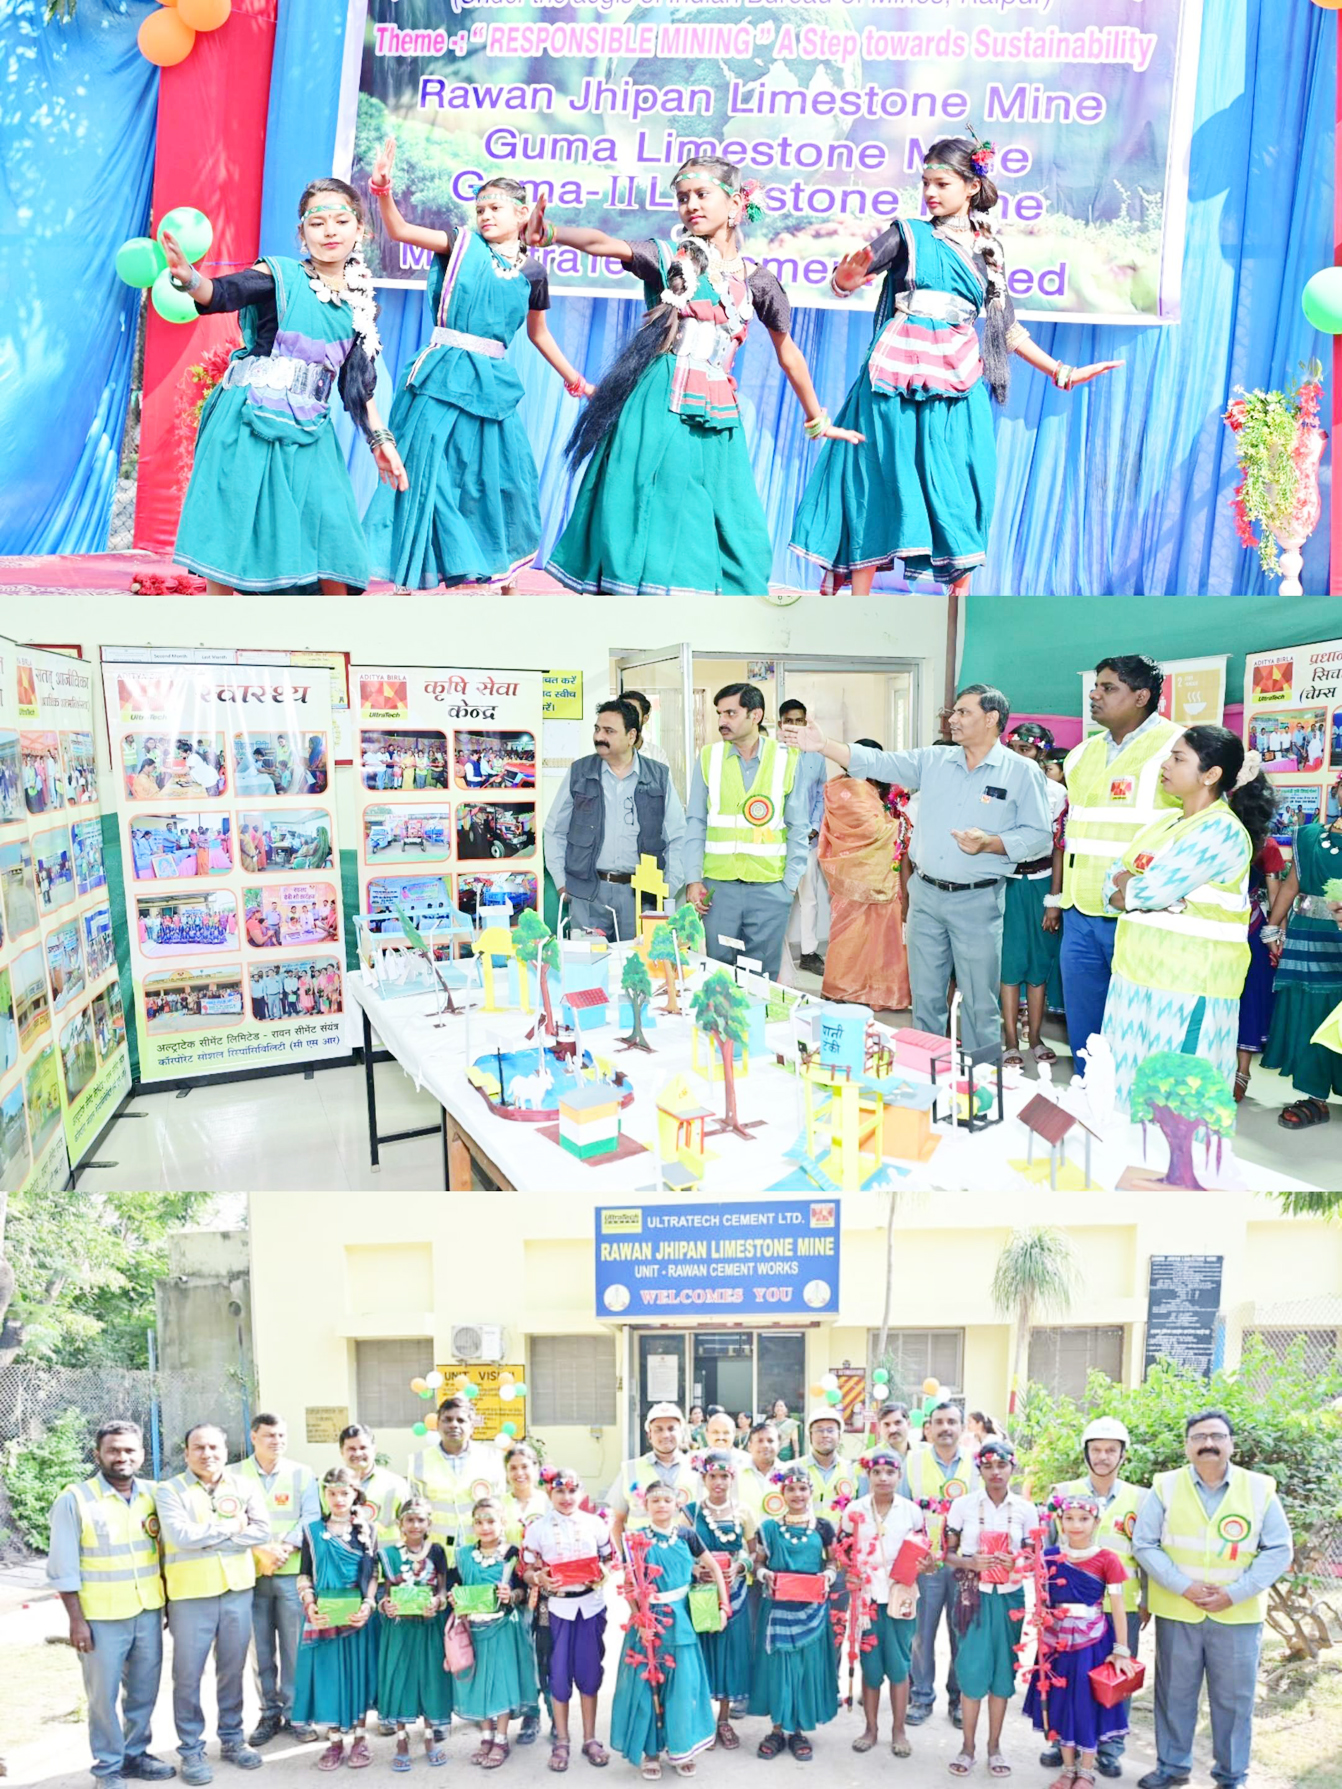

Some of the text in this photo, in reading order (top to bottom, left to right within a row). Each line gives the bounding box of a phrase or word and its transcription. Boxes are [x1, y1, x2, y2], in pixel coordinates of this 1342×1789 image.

[376, 27, 445, 55] Theme
[777, 29, 796, 57] A
[802, 29, 859, 61] Step
[865, 30, 966, 58] towards
[974, 30, 1153, 68] Sustainability
[420, 80, 1103, 121] Rawan Jhipan Limestone Mine
[485, 130, 617, 161] Guma
[638, 131, 886, 170] Limestone
[1254, 659, 1274, 667] ADITYA
[424, 676, 520, 701] कृषि सेवा
[1258, 694, 1285, 702] UltraTech
[448, 700, 499, 720] केन्द्र
[156, 1038, 195, 1053] अल्ट्राटेक
[200, 1036, 223, 1047] सीमेंट
[227, 1032, 260, 1044] लिमिटेड
[272, 1029, 291, 1039] रावन
[294, 1025, 317, 1036] सीमेंट
[320, 1022, 339, 1033] संयंत्र
[197, 1050, 224, 1061] सोशल
[289, 1039, 303, 1051] (सी
[306, 1038, 318, 1049] एस
[322, 1036, 340, 1048] आर)
[647, 1212, 805, 1228] ULTRATECH CEMENT LTD.
[601, 1237, 835, 1262] RAWAN JHIPAN LIMESTONE MINE
[635, 1265, 659, 1279] UNIT
[668, 1264, 707, 1278] RAWAN
[710, 1263, 755, 1277] CEMENT
[757, 1261, 799, 1275] WORKS
[640, 1287, 793, 1305] WELCOMES YOU
